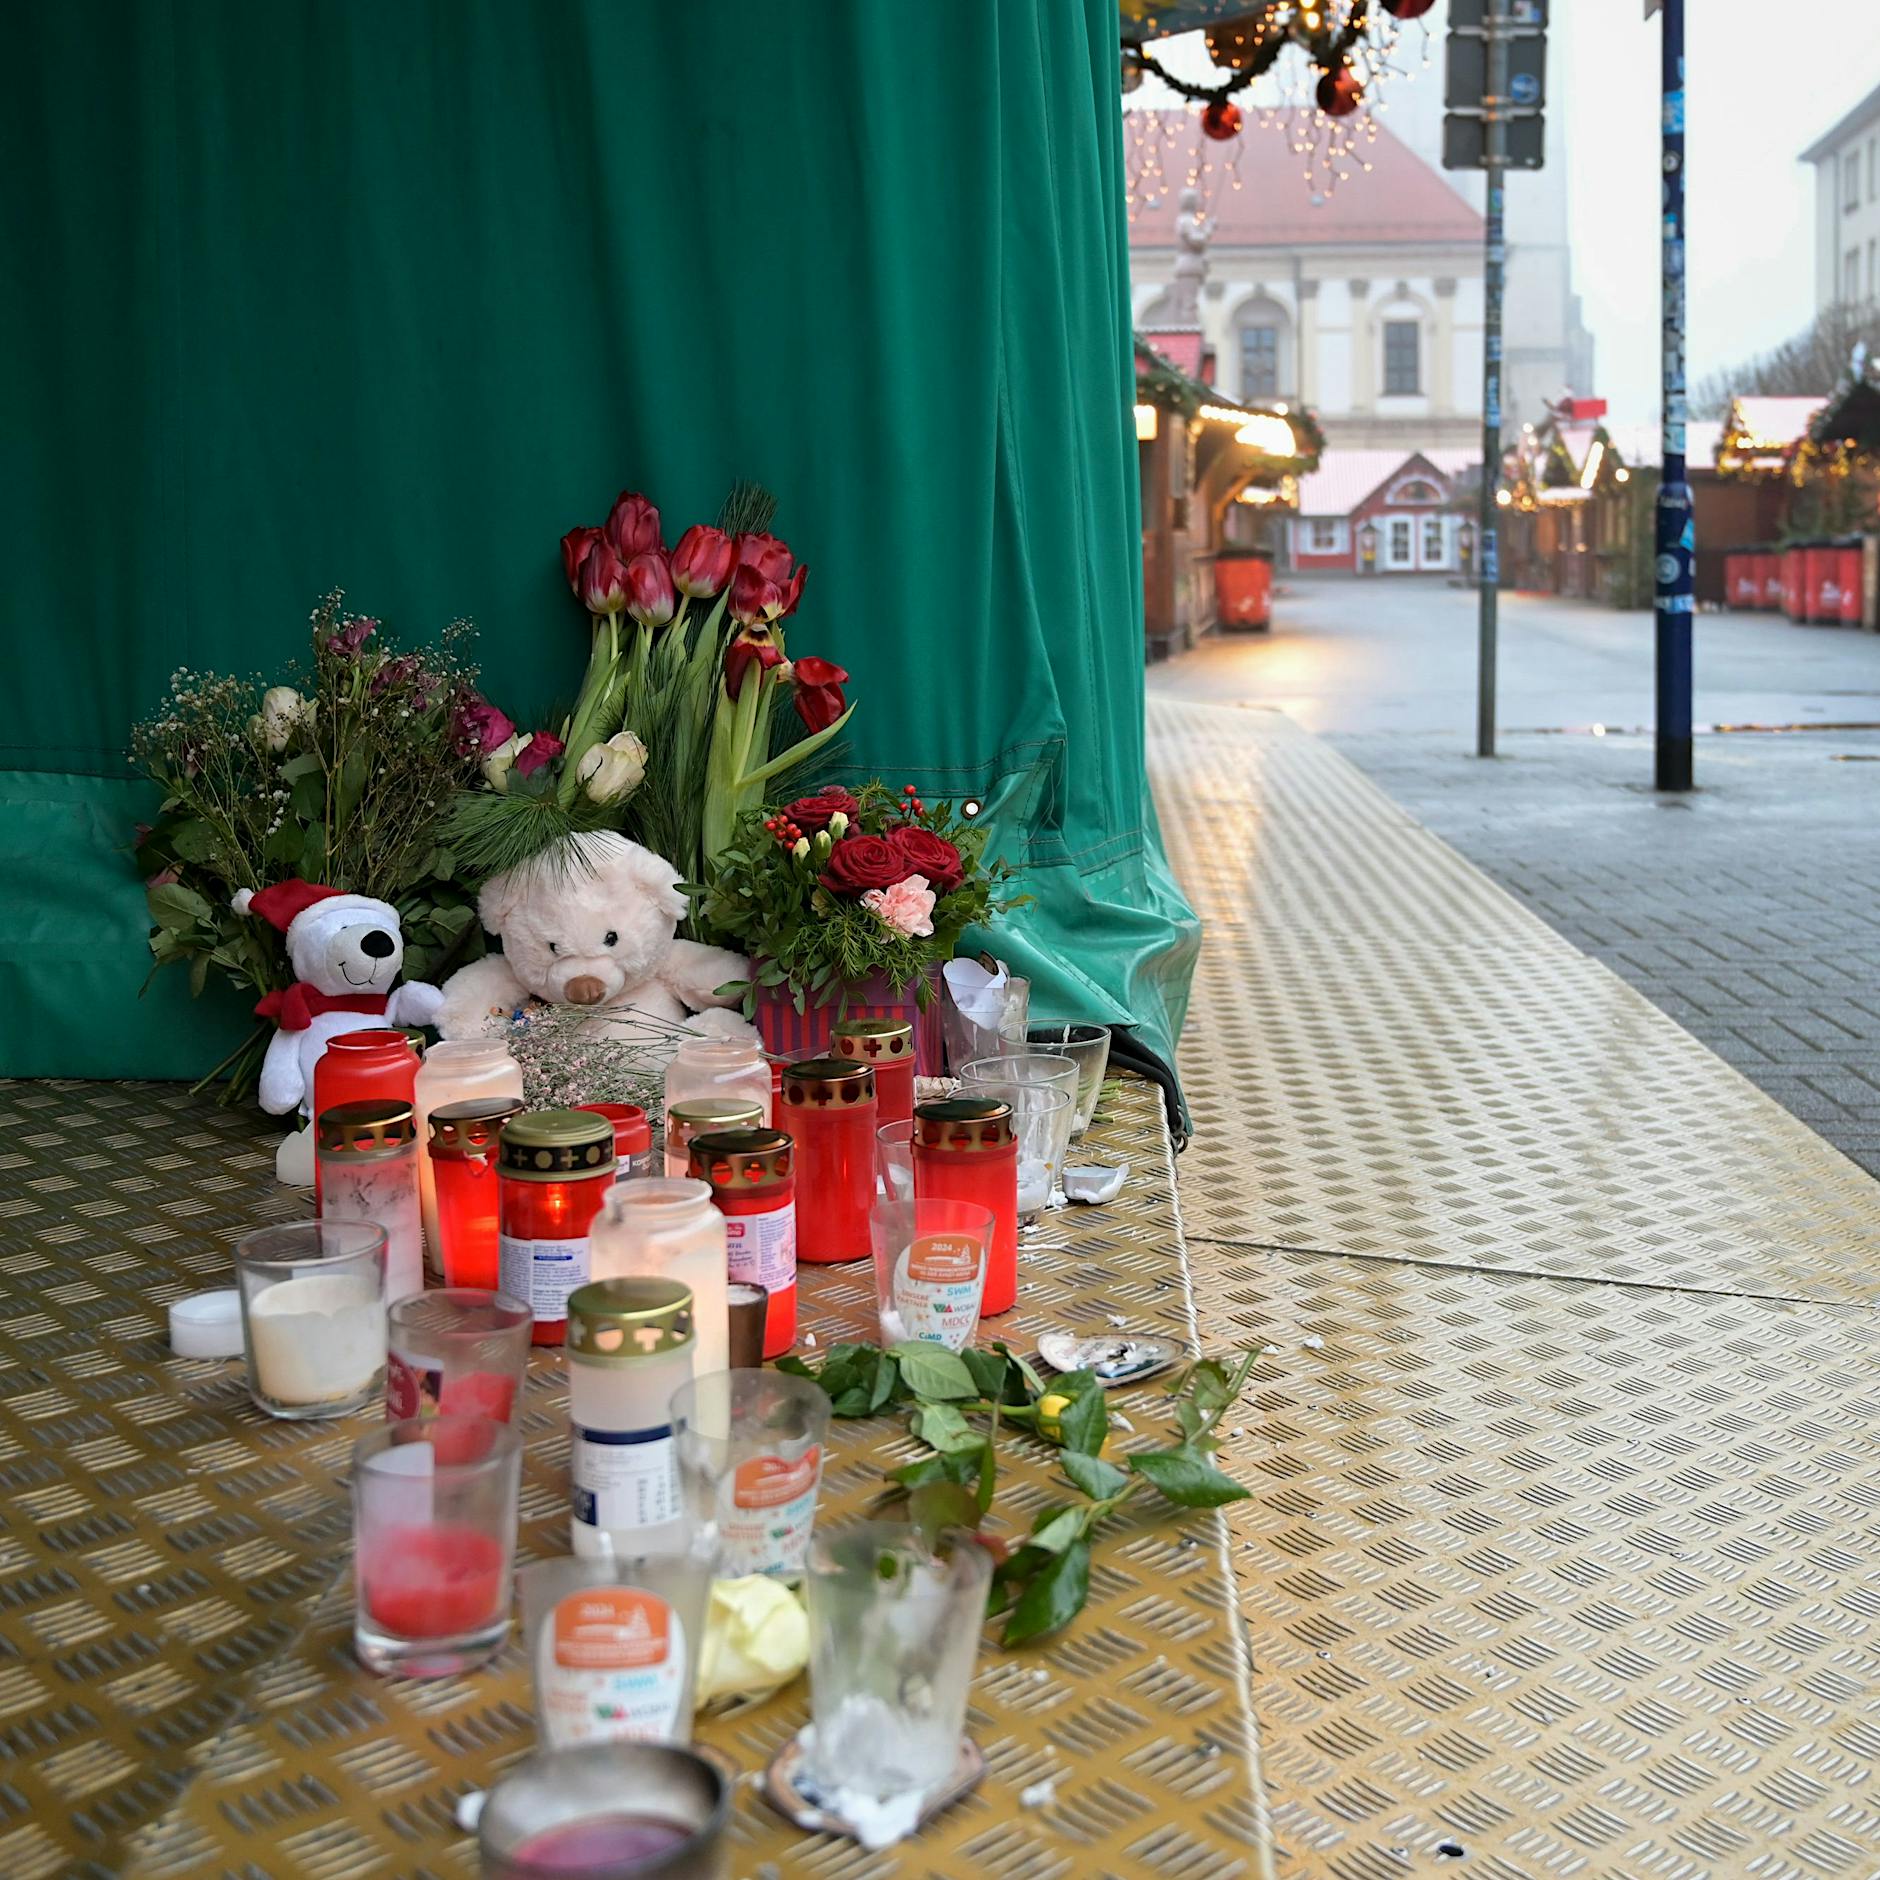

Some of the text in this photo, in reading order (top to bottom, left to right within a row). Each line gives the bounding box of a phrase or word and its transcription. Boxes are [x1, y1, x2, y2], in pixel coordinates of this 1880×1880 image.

[931, 1242, 953, 1252] 2024
[947, 1285, 971, 1297] SWM
[942, 1314, 969, 1327] MDCC
